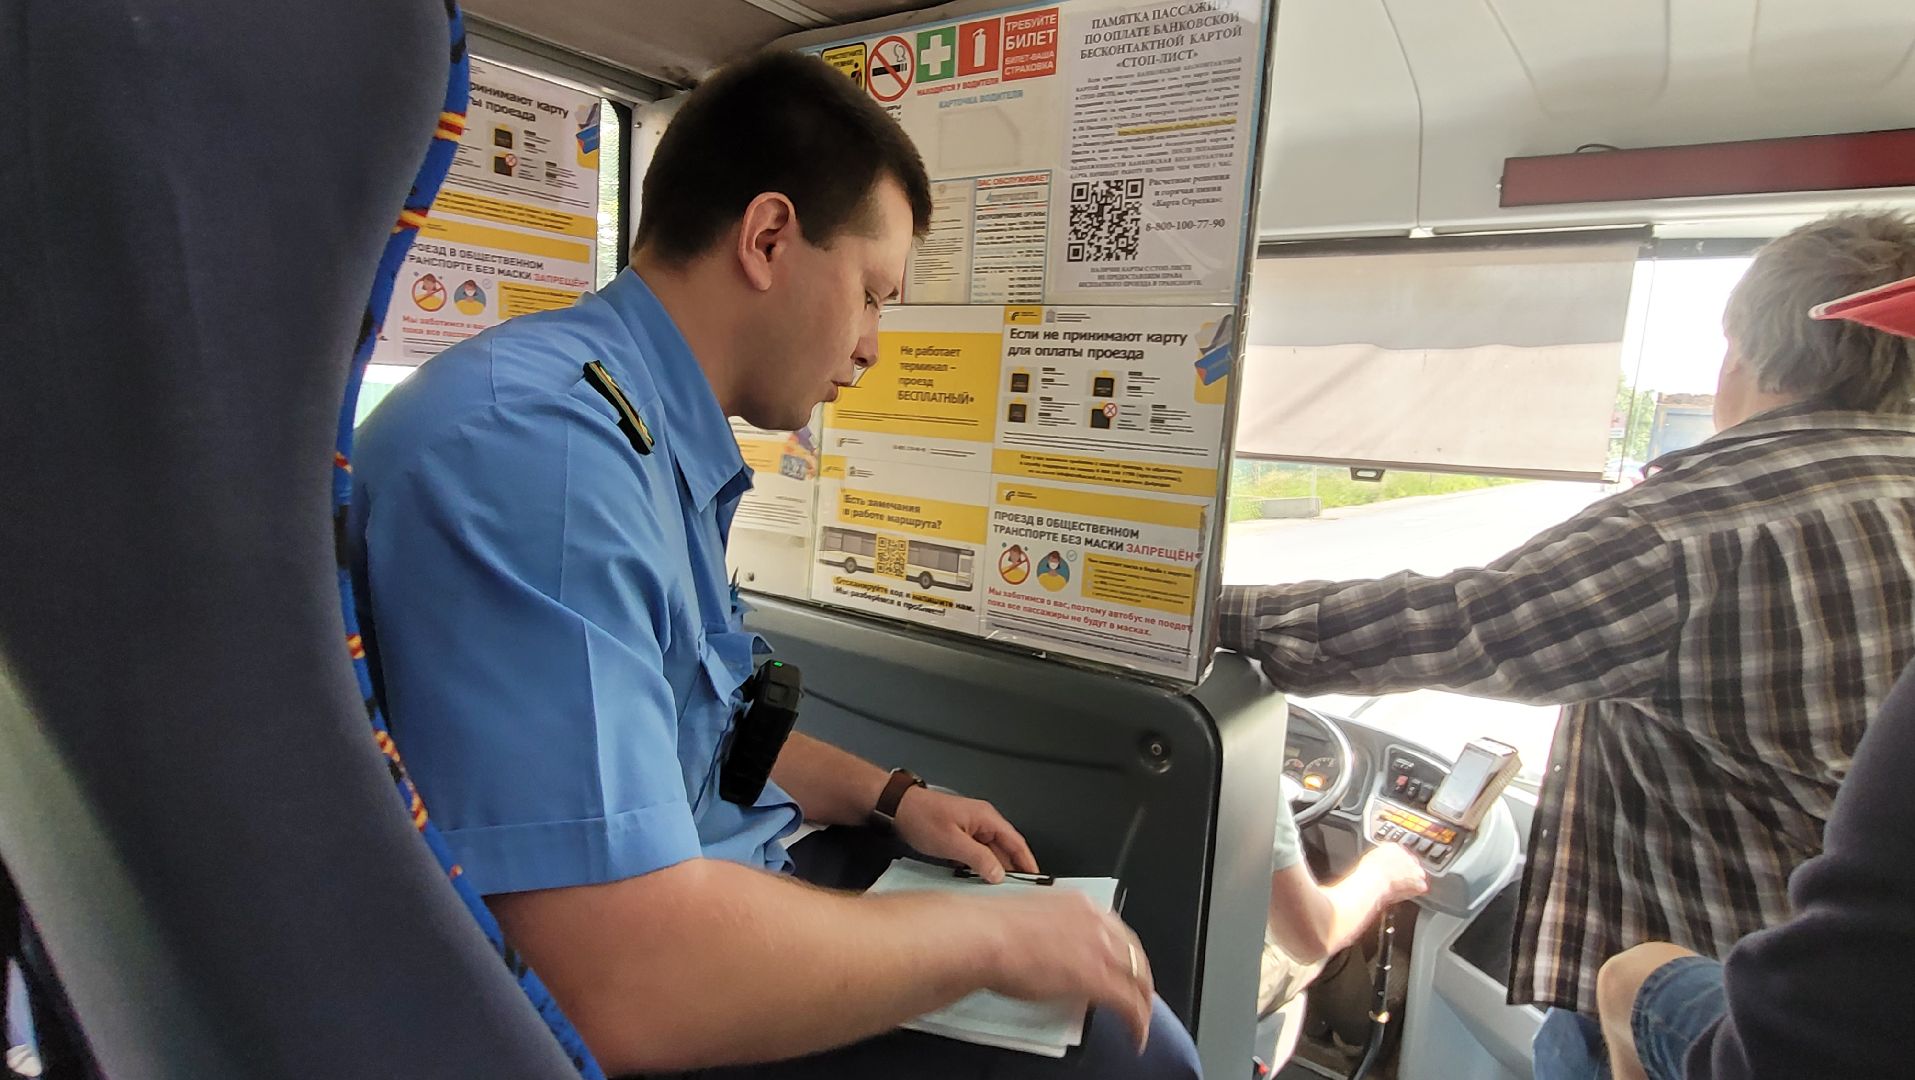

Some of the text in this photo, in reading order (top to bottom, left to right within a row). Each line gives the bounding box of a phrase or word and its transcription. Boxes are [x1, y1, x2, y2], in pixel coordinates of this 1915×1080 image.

[1005, 14, 1057, 32] ТРЕБУЙТЕ
[1092, 0, 1231, 29] ПАМЯТКА ПАССАЖИ
[1085, 12, 1240, 45] ПО ОПЛАТЕ БАНКОВСКОЙ
[1005, 29, 1057, 51] БИЛЕТ
[1080, 26, 1242, 59] БЕСКОНТАКТНОЙ КАРТОЙ
[1004, 61, 1054, 75] СТРАХОВКА
[1116, 49, 1199, 68] «СТОП-ЛИСТ»
[470, 82, 534, 106] ринимают
[537, 101, 569, 119] карту
[939, 96, 978, 108] КАРТОЧКА
[486, 101, 536, 122] проезда
[1145, 218, 1226, 232] 8-800-100-77-90
[408, 254, 473, 272] РАНСПОРТЕ
[475, 264, 495, 275] БЕЗ
[497, 269, 532, 281] МАСКИ
[449, 248, 457, 257] В
[459, 250, 544, 271] ОБЩЕСТВЕННОМ
[1009, 328, 1188, 346] Если не принимают карту
[900, 346, 961, 358] Не работает
[1008, 346, 1144, 360] для оплаты проезда
[900, 362, 948, 372] терминал
[899, 377, 934, 388] проезд
[844, 494, 921, 514] Есть замечания
[852, 508, 885, 521] работе
[887, 515, 942, 530] маршрута?
[994, 511, 1140, 540] ПРОЕЗД В ОБЩЕСТВЕННОМ
[994, 524, 1058, 542] ТРАНСПОРТЕ
[1061, 534, 1082, 545] БЕЗ
[1084, 537, 1124, 552] МАСКИ
[835, 586, 848, 595] Мы
[889, 590, 904, 598] код
[988, 586, 1001, 596] Мы
[1003, 590, 1045, 604] заботимся
[1053, 599, 1070, 610] вас,
[1071, 603, 1106, 617] поэтому
[1108, 609, 1143, 623] автобус
[1144, 616, 1156, 625] не
[988, 599, 1006, 608] пока
[1007, 603, 1021, 611] все
[1022, 605, 1070, 621] пассажиры
[1071, 614, 1082, 623] не
[1083, 615, 1107, 630] будут
[1116, 623, 1152, 636] масках.
